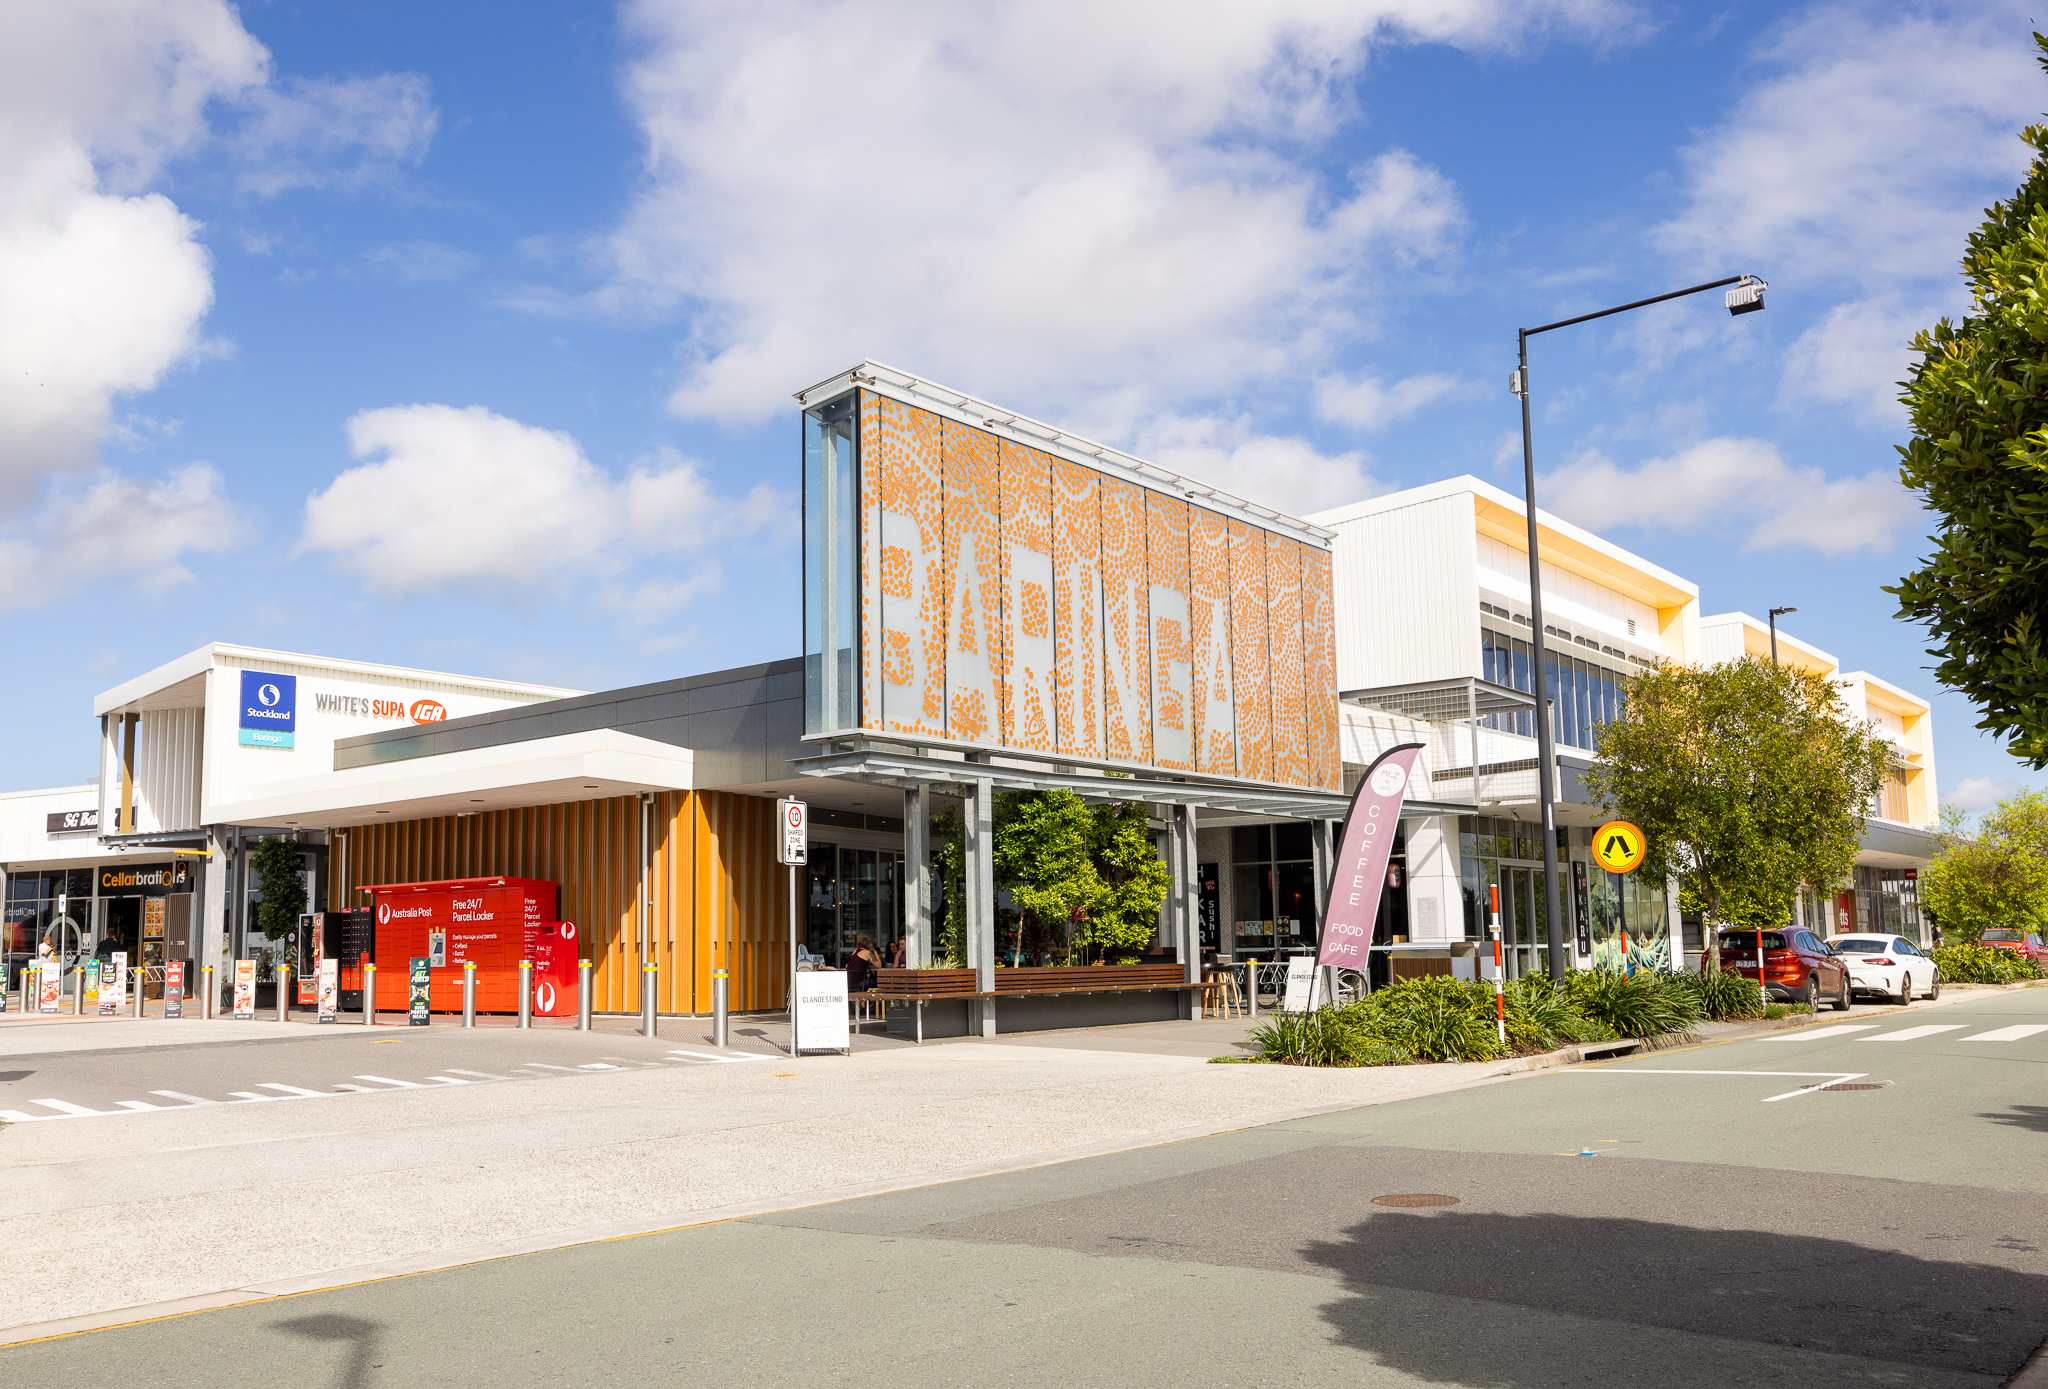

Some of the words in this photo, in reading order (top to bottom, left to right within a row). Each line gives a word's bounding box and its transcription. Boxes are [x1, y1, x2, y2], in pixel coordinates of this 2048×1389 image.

[247, 707, 290, 720] Stockland
[316, 693, 369, 715] WHITE'S
[373, 700, 405, 718] SUPA
[414, 704, 443, 721] IGA
[64, 811, 80, 829] SG
[791, 812, 800, 822] 10
[787, 829, 804, 837] SHARED
[1349, 804, 1381, 906] COFFEE
[453, 899, 466, 909] Free
[467, 898, 483, 909] 24/7
[1577, 863, 1586, 953] HIKARU
[392, 906, 417, 918] Australia
[418, 905, 433, 917] Post
[453, 911, 472, 922] Parcel
[473, 911, 494, 921] Locker
[1331, 923, 1364, 937] FOOD
[1328, 942, 1359, 956] CAFE
[802, 995, 843, 1004] CLANDESTINO
